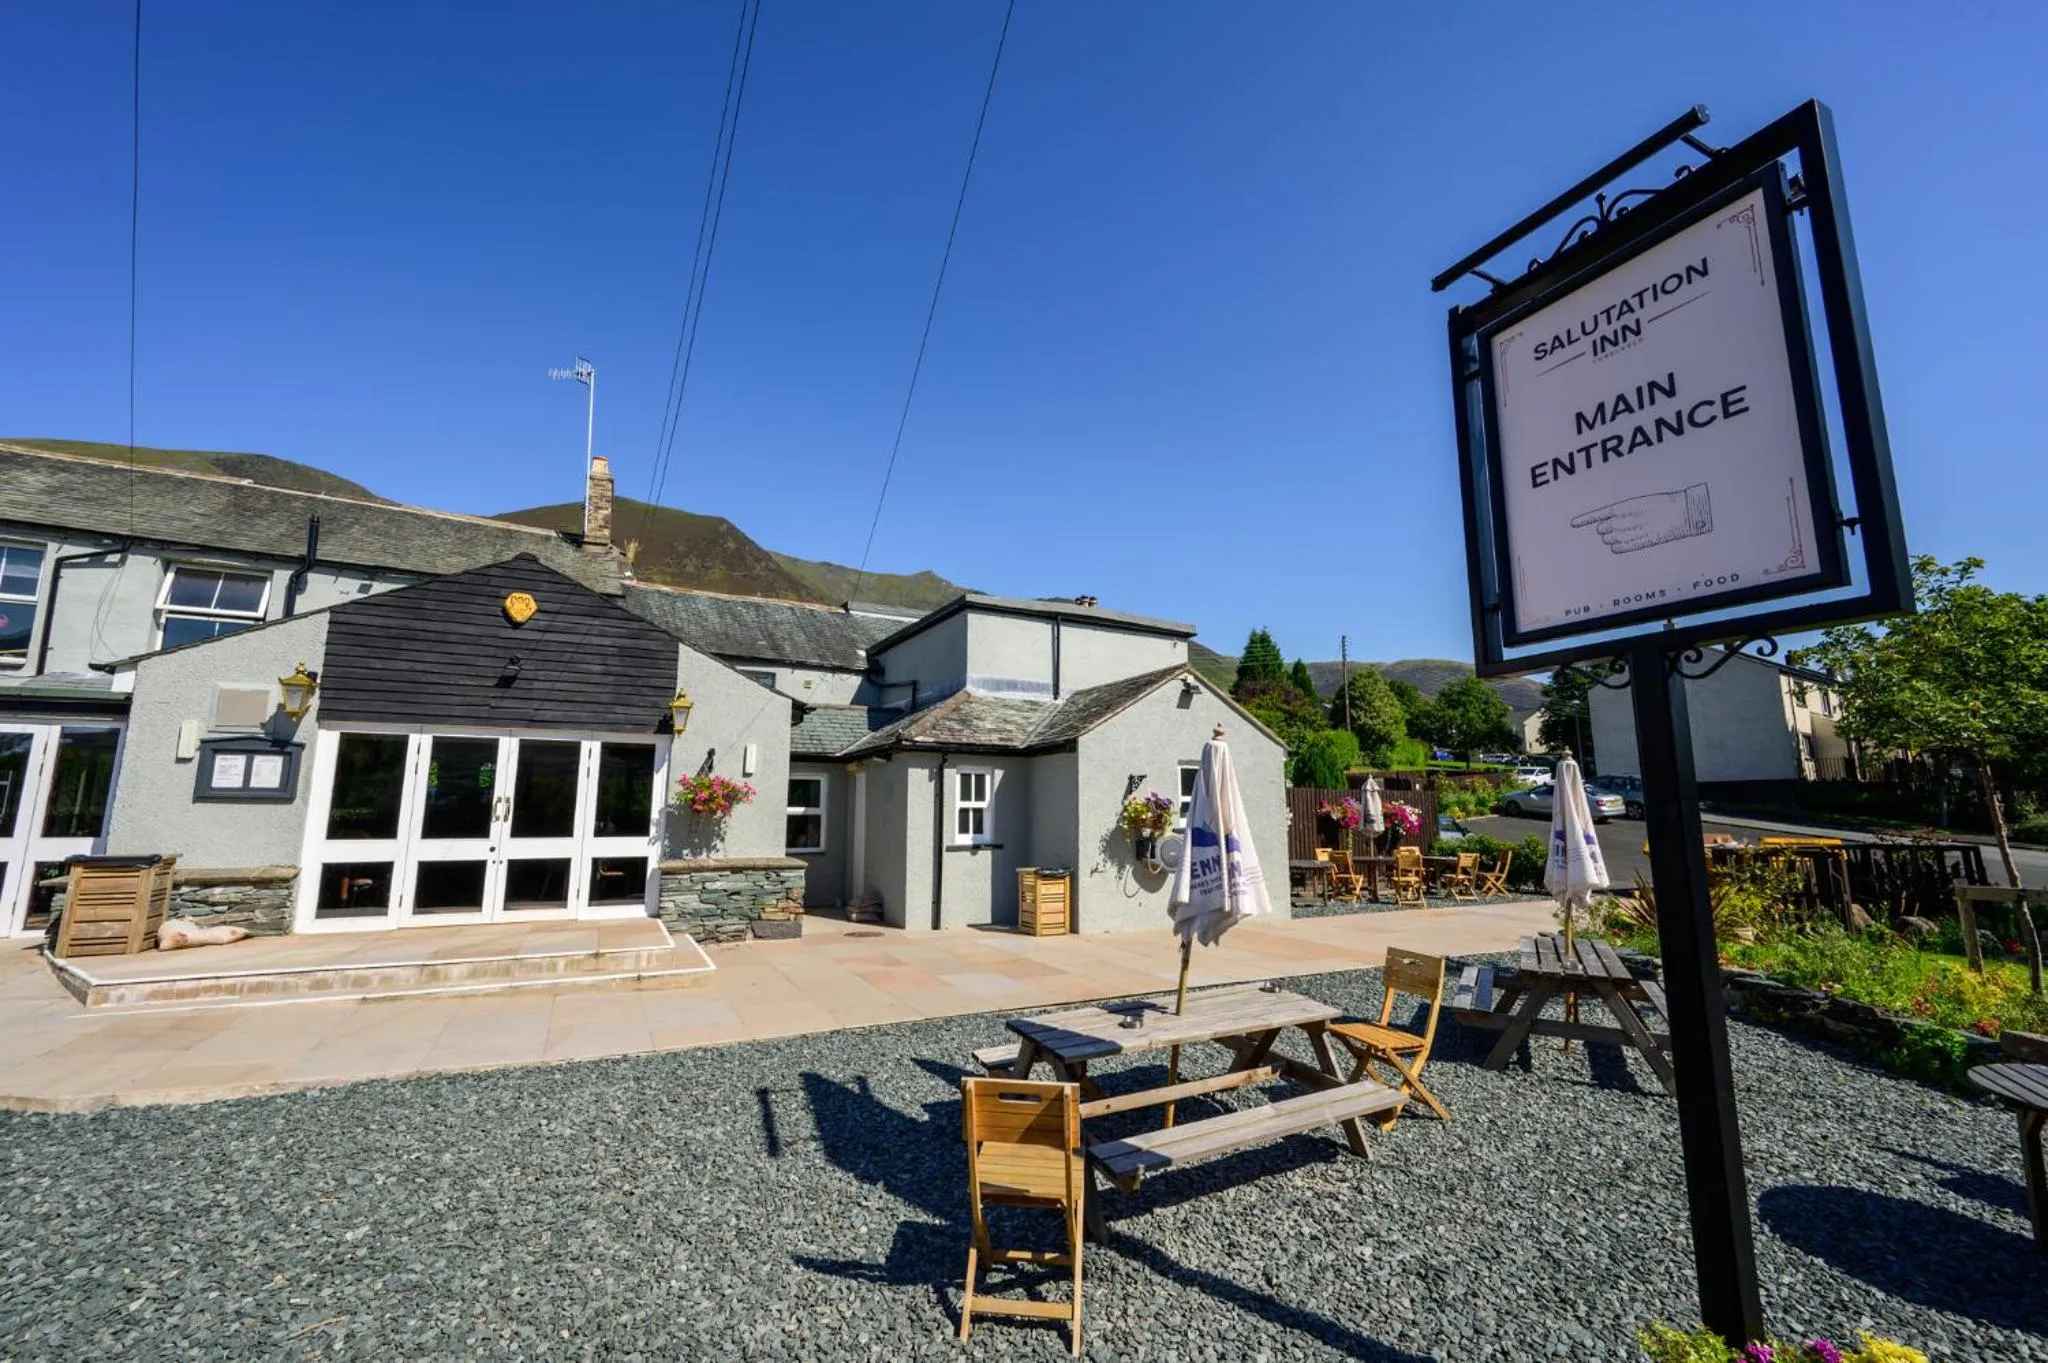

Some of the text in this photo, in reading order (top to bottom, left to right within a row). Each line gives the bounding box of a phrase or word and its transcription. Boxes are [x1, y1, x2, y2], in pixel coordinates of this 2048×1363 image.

[1533, 256, 1709, 361] SALUTATION
[1592, 317, 1642, 357] INN
[1575, 371, 1677, 436] MAIN
[1530, 384, 1750, 489] ENTRANCE
[1564, 573, 1740, 617] PUB ROOMS FOOD
